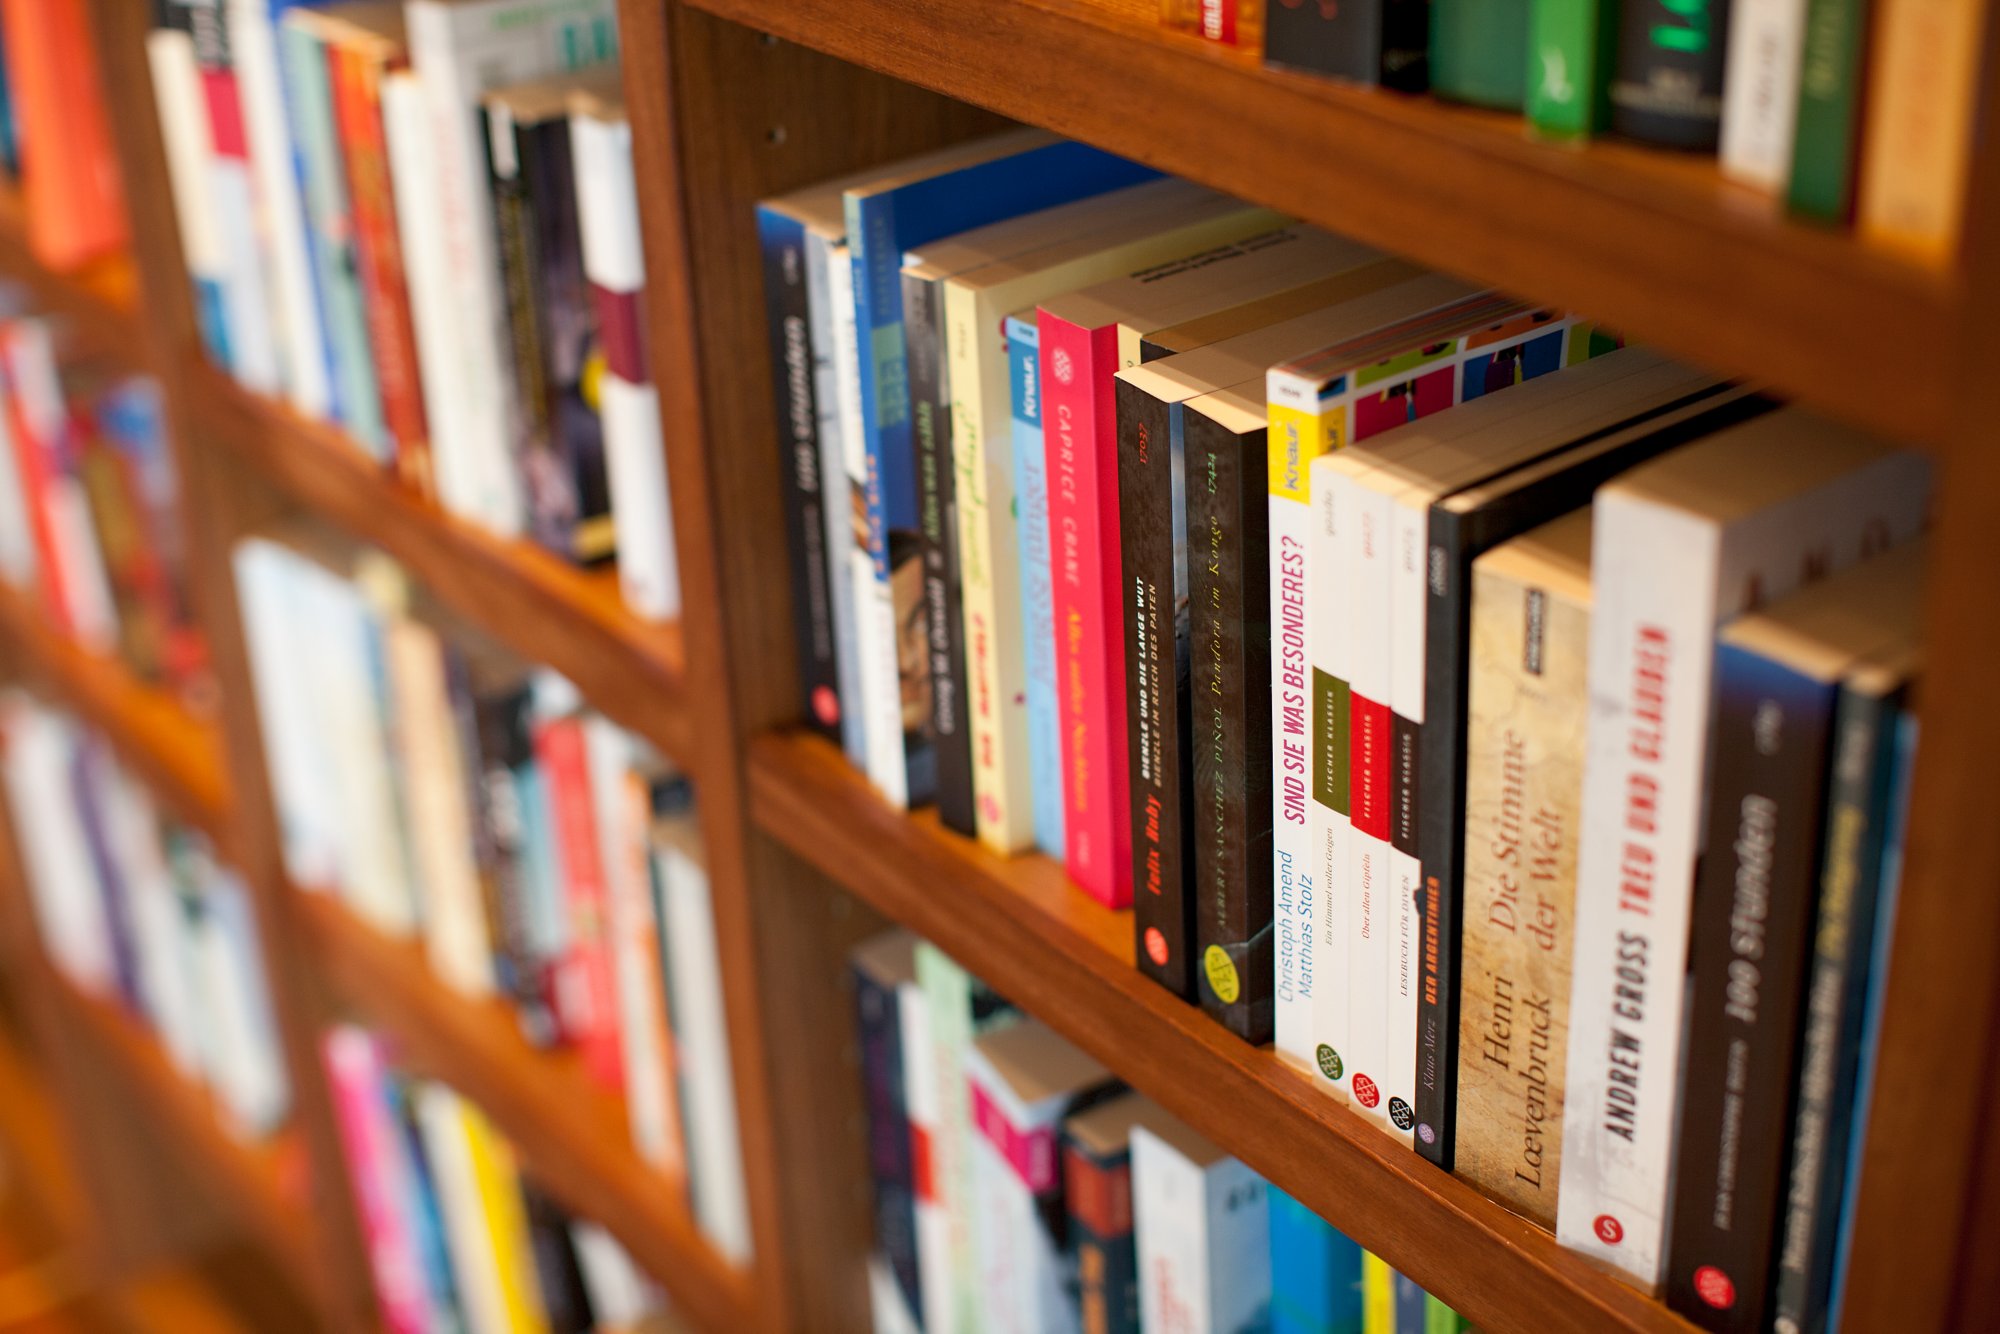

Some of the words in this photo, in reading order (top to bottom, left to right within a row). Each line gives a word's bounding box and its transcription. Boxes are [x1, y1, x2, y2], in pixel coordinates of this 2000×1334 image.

[1057, 404, 1076, 505] CAPRICE
[1138, 422, 1149, 465] 17037
[1207, 452, 1218, 495] 17424
[1061, 516, 1080, 588] CRANE
[1208, 516, 1222, 577] Kongo
[1136, 576, 1144, 608] WUT
[1149, 584, 1157, 630] PATEN
[1209, 588, 1220, 609] im
[1280, 535, 1304, 690] BESONDERES?
[1137, 611, 1147, 659] LANGE
[1149, 635, 1158, 661] DES
[1209, 620, 1222, 696] Pandora
[1139, 661, 1147, 686] DIE
[1150, 664, 1160, 706] REICH
[1628, 623, 1670, 764] GLAUBEN
[1139, 688, 1148, 718] UND
[1152, 709, 1161, 727] IM
[1282, 691, 1305, 736] WAS
[1327, 691, 1335, 739] KLASSIK
[1140, 720, 1151, 780] BIENZLE
[1153, 729, 1163, 788] BIENZLE
[1212, 706, 1223, 763] PIÑOL
[1283, 739, 1305, 775] SIE
[1364, 714, 1373, 764] KLASSIK
[1402, 734, 1412, 784] KLASSIK
[1144, 793, 1163, 843] Huby
[1284, 776, 1306, 825] SIND
[1364, 769, 1372, 818] FISCHER
[1401, 788, 1411, 839] FISCHER
[1491, 729, 1525, 868] Stimme
[1624, 772, 1660, 836] UND
[1326, 827, 1335, 860] Geigen
[1530, 805, 1563, 882] Welt
[1147, 847, 1163, 896] Felix
[1277, 849, 1293, 916] Amend
[1325, 861, 1333, 887] voller
[1363, 853, 1373, 889] Gipfeln
[1401, 874, 1410, 912] DIVEN
[1618, 840, 1656, 917] TREU
[1215, 866, 1227, 928] ALBERT
[1297, 874, 1312, 919] Stolz
[1325, 887, 1333, 928] Himmel
[1488, 873, 1520, 935] Die
[1325, 929, 1333, 946] Ein
[1361, 915, 1371, 940] Über
[1426, 876, 1441, 974] ARGENTINIER
[1526, 893, 1557, 952] der
[1277, 917, 1297, 1003] Christoph
[1297, 921, 1312, 999] Matthias
[1400, 937, 1409, 997] LESEBUCH
[1611, 929, 1649, 1022] GROSS
[1425, 975, 1438, 1006] DER
[1424, 1016, 1436, 1053] Merz
[1483, 971, 1514, 1072] Henri
[1423, 1054, 1435, 1091] Klaus
[1604, 1028, 1642, 1143] ANDREW
